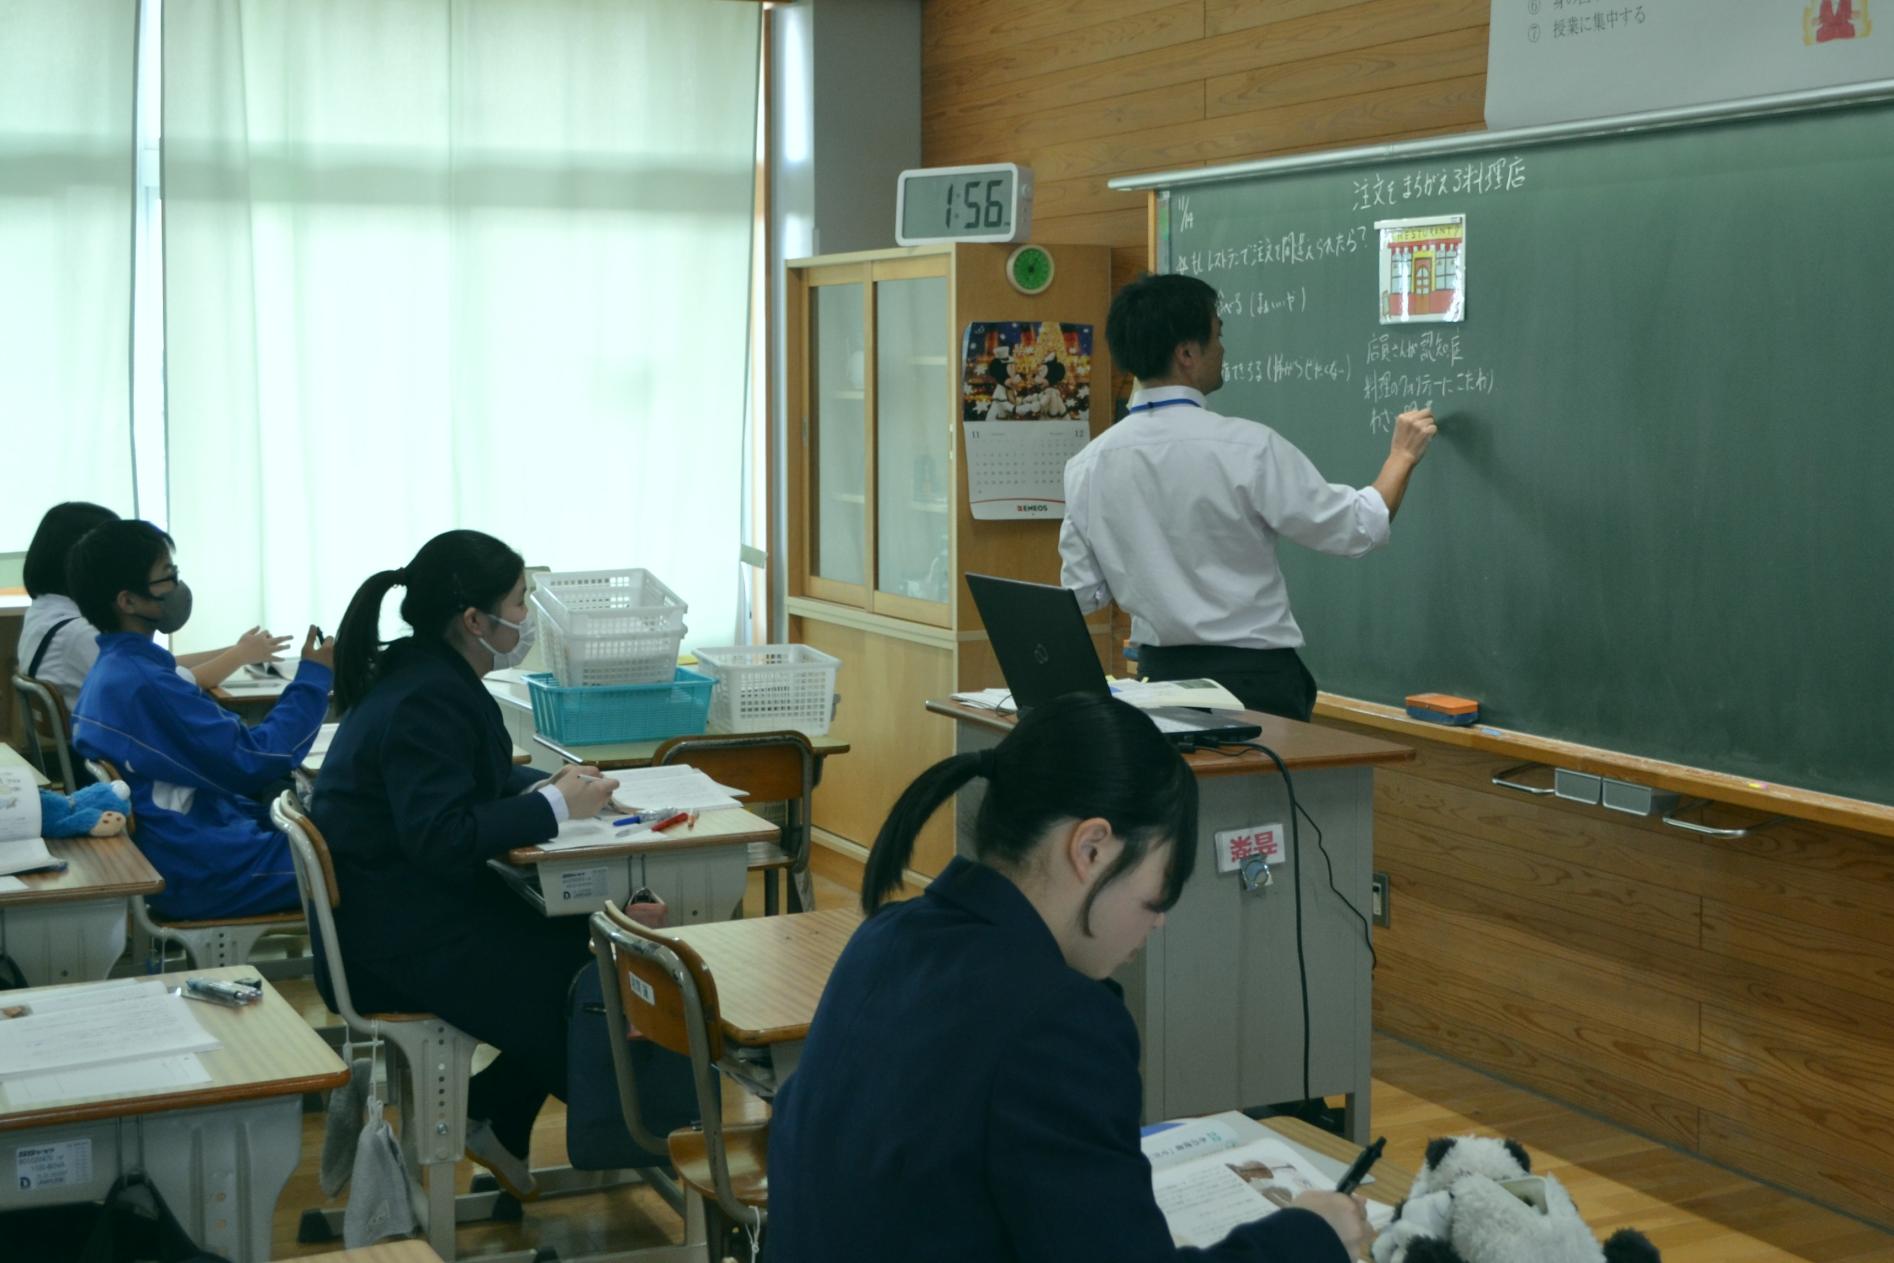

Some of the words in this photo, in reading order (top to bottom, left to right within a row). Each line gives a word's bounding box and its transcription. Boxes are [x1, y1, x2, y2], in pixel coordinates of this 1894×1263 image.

[1553, 5, 1647, 39] 授業に集中する
[945, 179, 1004, 229] 1:56
[20, 1177, 31, 1189] D
